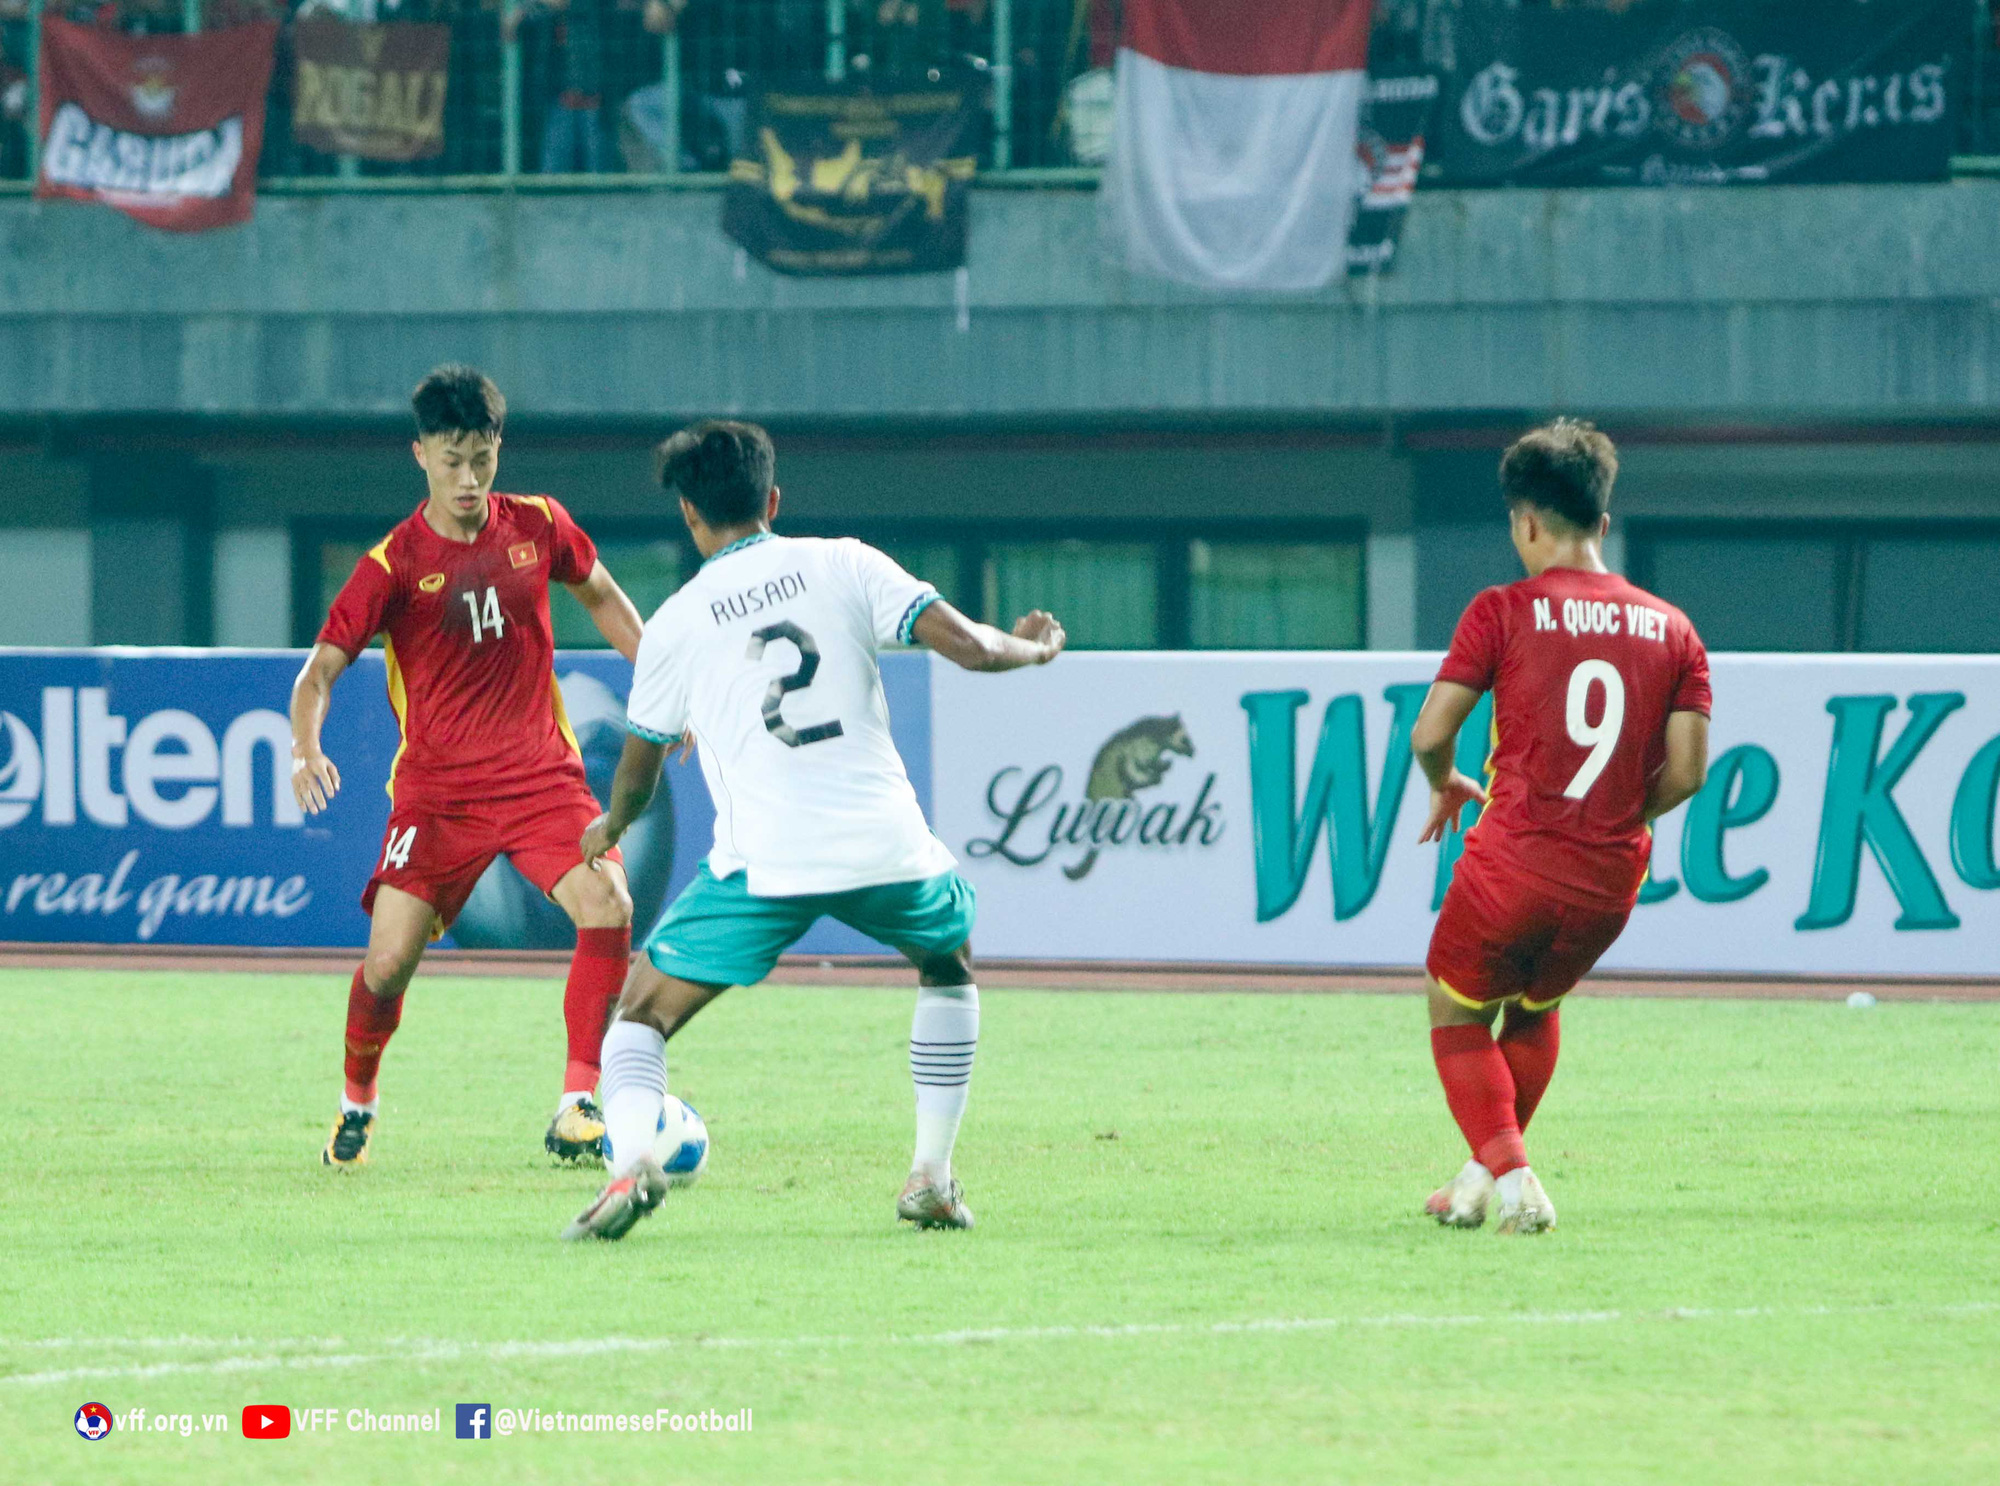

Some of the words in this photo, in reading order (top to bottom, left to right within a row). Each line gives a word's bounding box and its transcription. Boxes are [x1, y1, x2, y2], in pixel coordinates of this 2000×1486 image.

[462, 586, 504, 644] 14
[710, 571, 807, 626] RUSADI
[1533, 597, 1557, 631] N.
[1562, 598, 1620, 637] QUOC
[1625, 603, 1668, 642] VIET
[745, 620, 844, 748] 2
[1562, 658, 1626, 799] 9
[382, 825, 418, 871] 14
[966, 764, 1226, 866] Luwak
[4, 849, 133, 915] real
[136, 872, 313, 941] game
